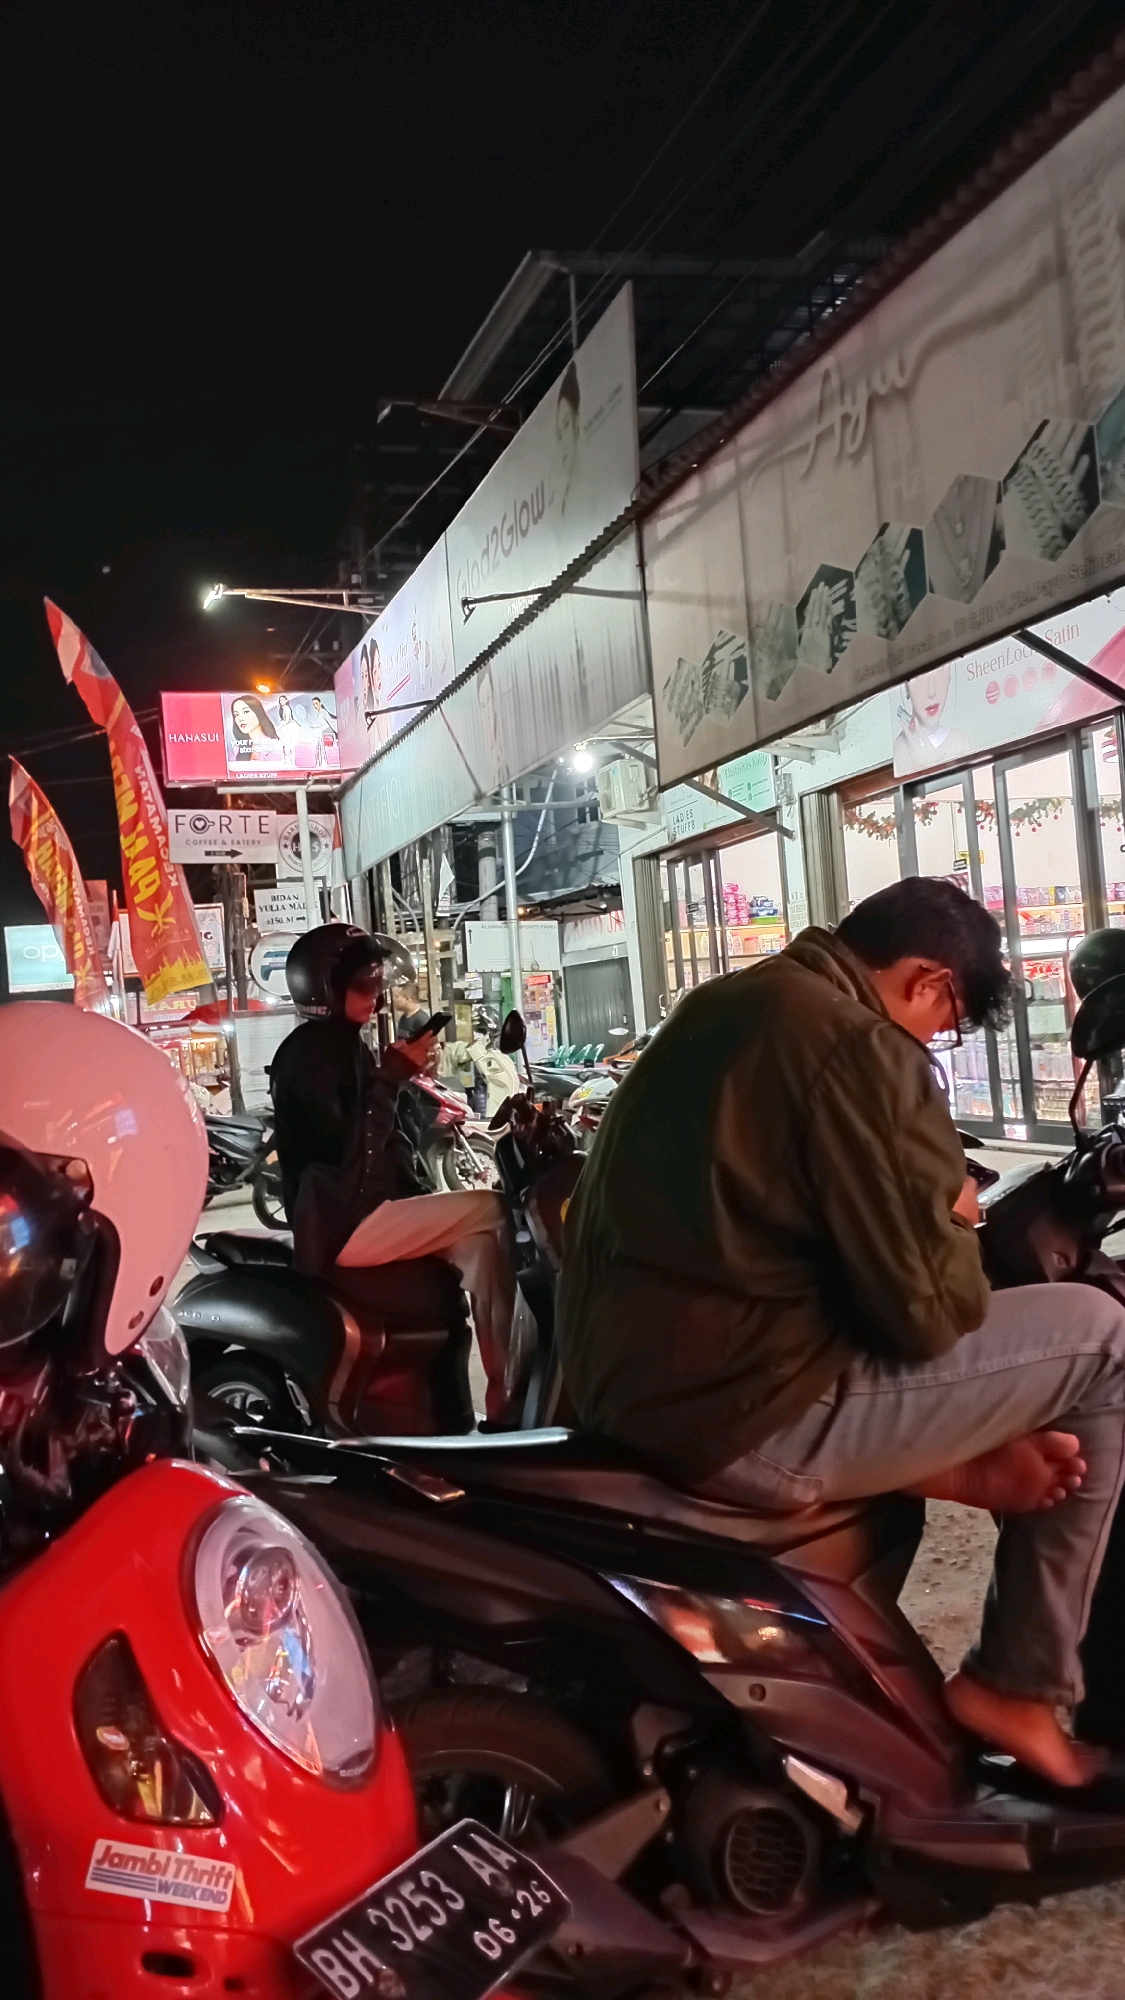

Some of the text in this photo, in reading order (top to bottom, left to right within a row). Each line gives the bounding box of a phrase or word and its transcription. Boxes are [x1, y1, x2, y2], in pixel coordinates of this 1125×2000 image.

[457, 480, 545, 602] Glad2Glow
[1044, 621, 1080, 648] Satin
[168, 733, 219, 743] HANASUI
[175, 814, 270, 834] FORTE
[672, 808, 694, 826] LADIES
[259, 904, 286, 913] YULIA
[270, 894, 299, 902] BIDAN
[95, 1845, 233, 1889] Jambi Thrift
[157, 1878, 228, 1904] WEEKEND
[311, 1833, 517, 1998] BH 3253 AA
